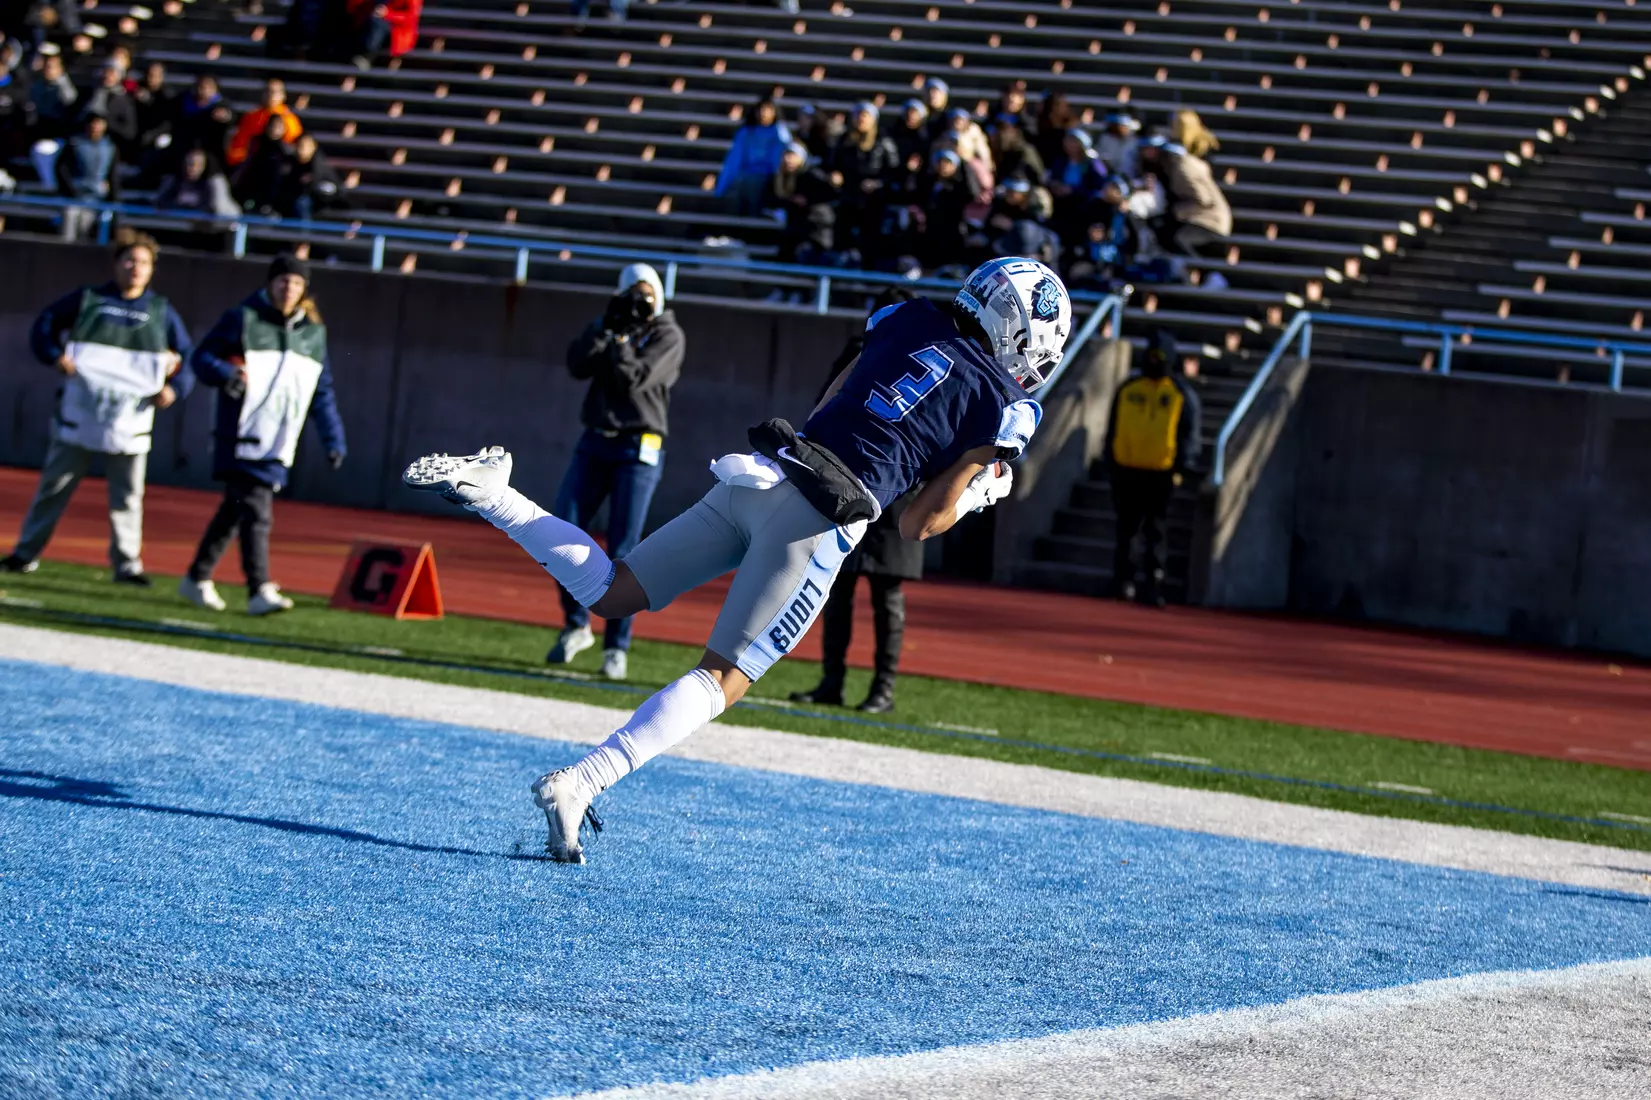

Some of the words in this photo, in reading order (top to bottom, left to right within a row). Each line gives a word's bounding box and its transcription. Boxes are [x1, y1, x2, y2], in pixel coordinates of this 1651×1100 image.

[864, 345, 954, 422] 3
[350, 547, 404, 606] G
[768, 577, 823, 651] LIONS
